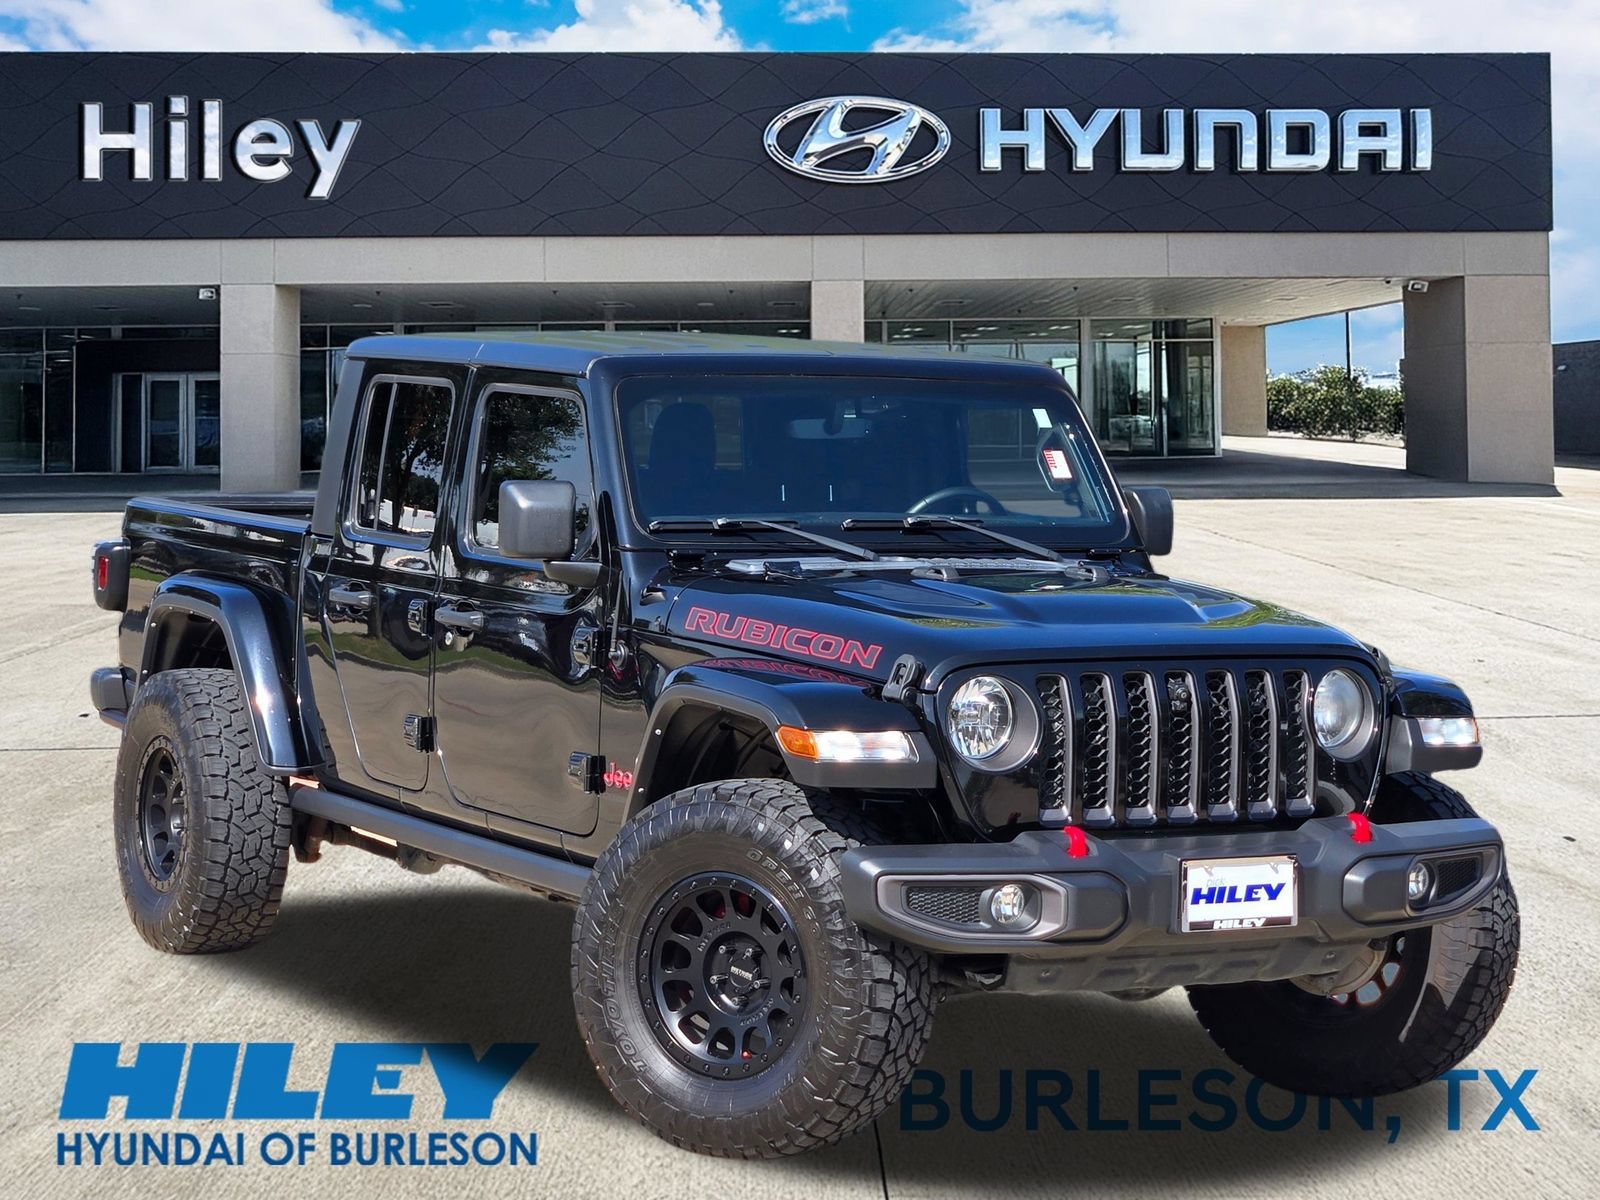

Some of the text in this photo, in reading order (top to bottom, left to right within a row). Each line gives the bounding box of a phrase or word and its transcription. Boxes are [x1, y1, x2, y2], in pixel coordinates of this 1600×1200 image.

[81, 95, 361, 200] Hiley
[979, 107, 1433, 172] HYUNDAI
[685, 606, 883, 670] RUBICON
[603, 761, 633, 789] Jee
[1190, 882, 1286, 905] HILEY
[1213, 918, 1267, 930] HILEY
